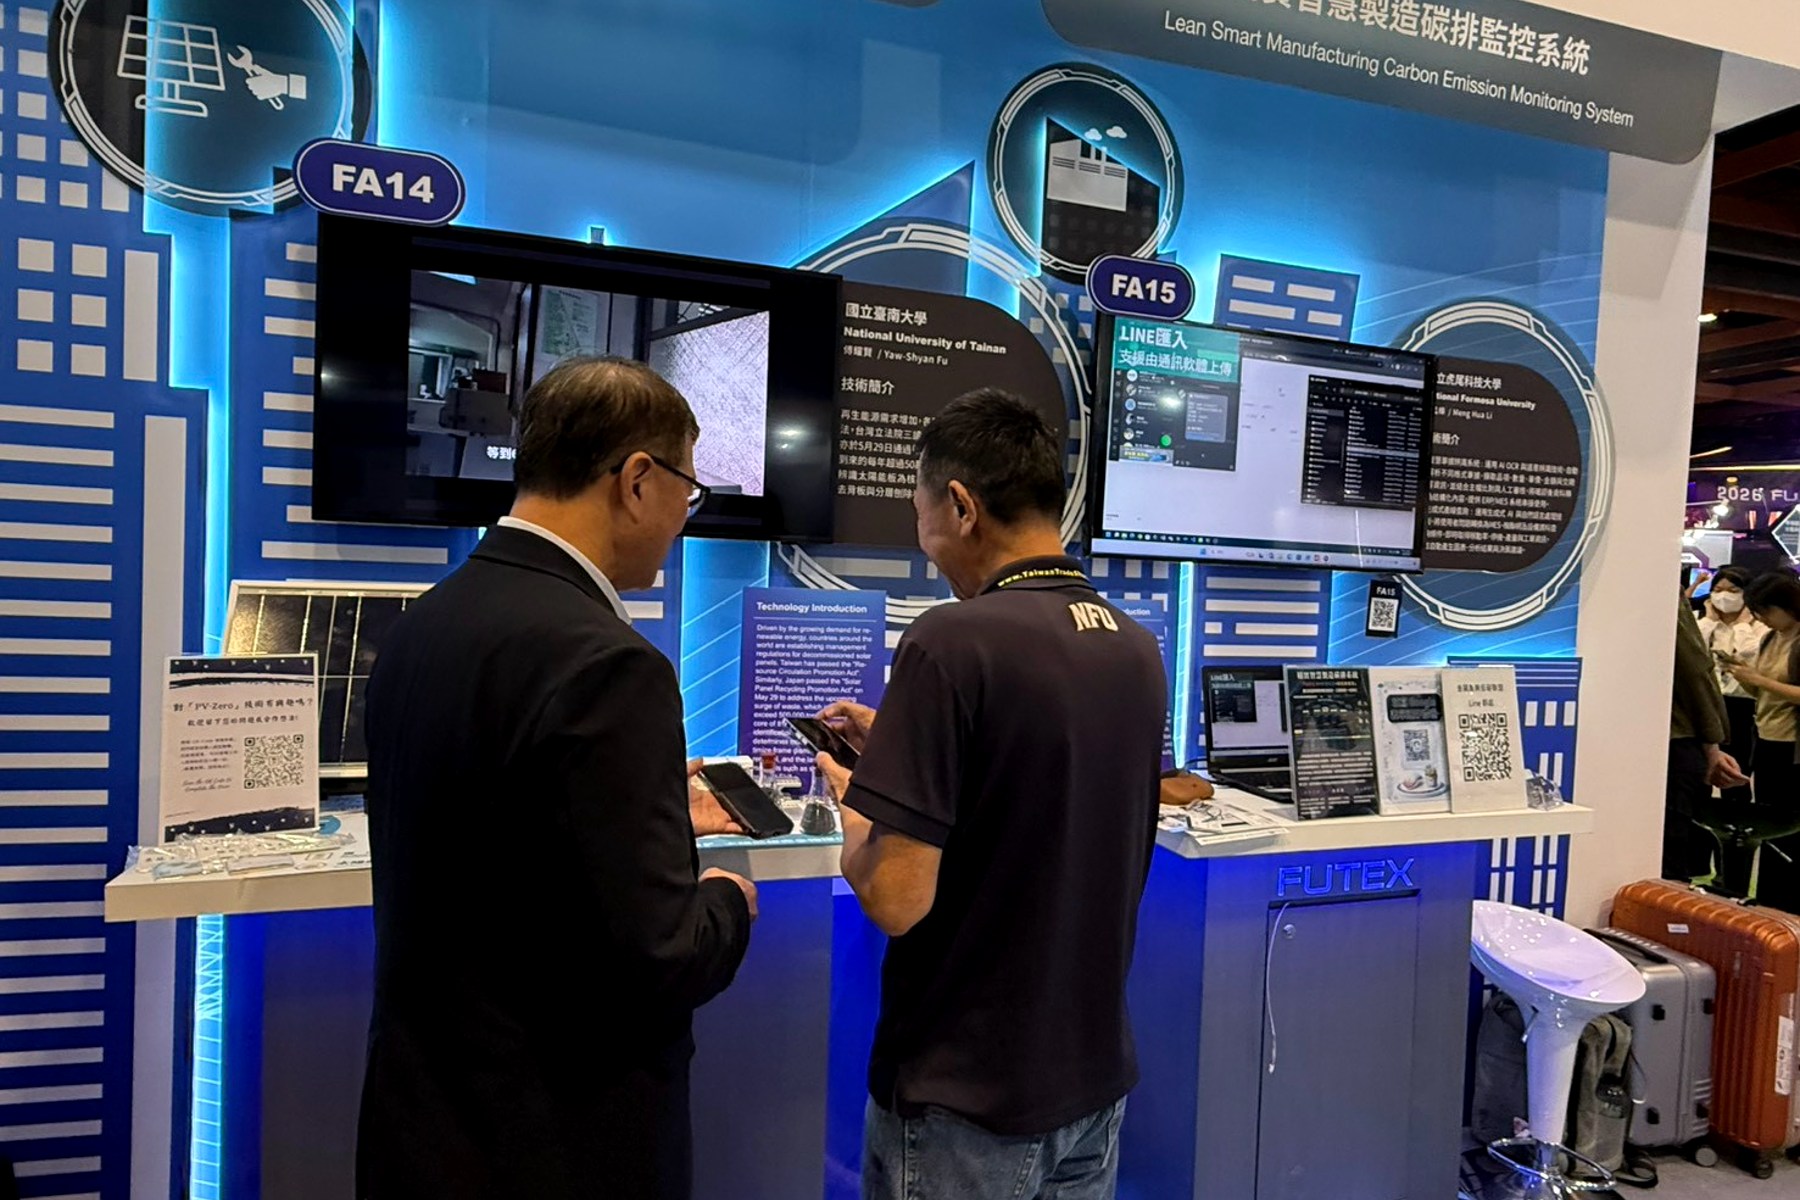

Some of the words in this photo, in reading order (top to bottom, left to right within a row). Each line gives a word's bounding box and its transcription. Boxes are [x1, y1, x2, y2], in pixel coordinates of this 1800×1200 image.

[1252, 0, 1591, 76] 慧製造碳排監控系統
[1164, 10, 1206, 37] Lean
[1211, 20, 1262, 48] Smart
[1266, 32, 1380, 77] Manufacturing
[1383, 57, 1439, 85] Carbon
[1442, 70, 1507, 100] Emission
[1510, 84, 1583, 120] Monitoring
[1585, 101, 1634, 128] System
[332, 163, 435, 204] FA14
[1111, 273, 1177, 304] FA15
[845, 302, 928, 326] 國立臺南大學
[843, 326, 892, 341] National
[895, 333, 953, 350] University
[955, 340, 967, 350] of
[969, 341, 1007, 354] Tainan
[1118, 325, 1188, 350] LINE匯入
[884, 350, 935, 365] Yaw-Shyan
[936, 355, 948, 366] Fu
[841, 376, 895, 395] 技術簡介
[1460, 394, 1495, 405] Formosa
[1496, 397, 1536, 411] University
[756, 602, 810, 614] Technology
[811, 603, 868, 613] Introduction
[1068, 602, 1119, 631] NFU
[757, 624, 777, 632] Driven
[778, 625, 787, 633] by
[786, 643, 824, 651] establishing
[754, 694, 769, 702] May
[1277, 858, 1415, 897] FUTEX
